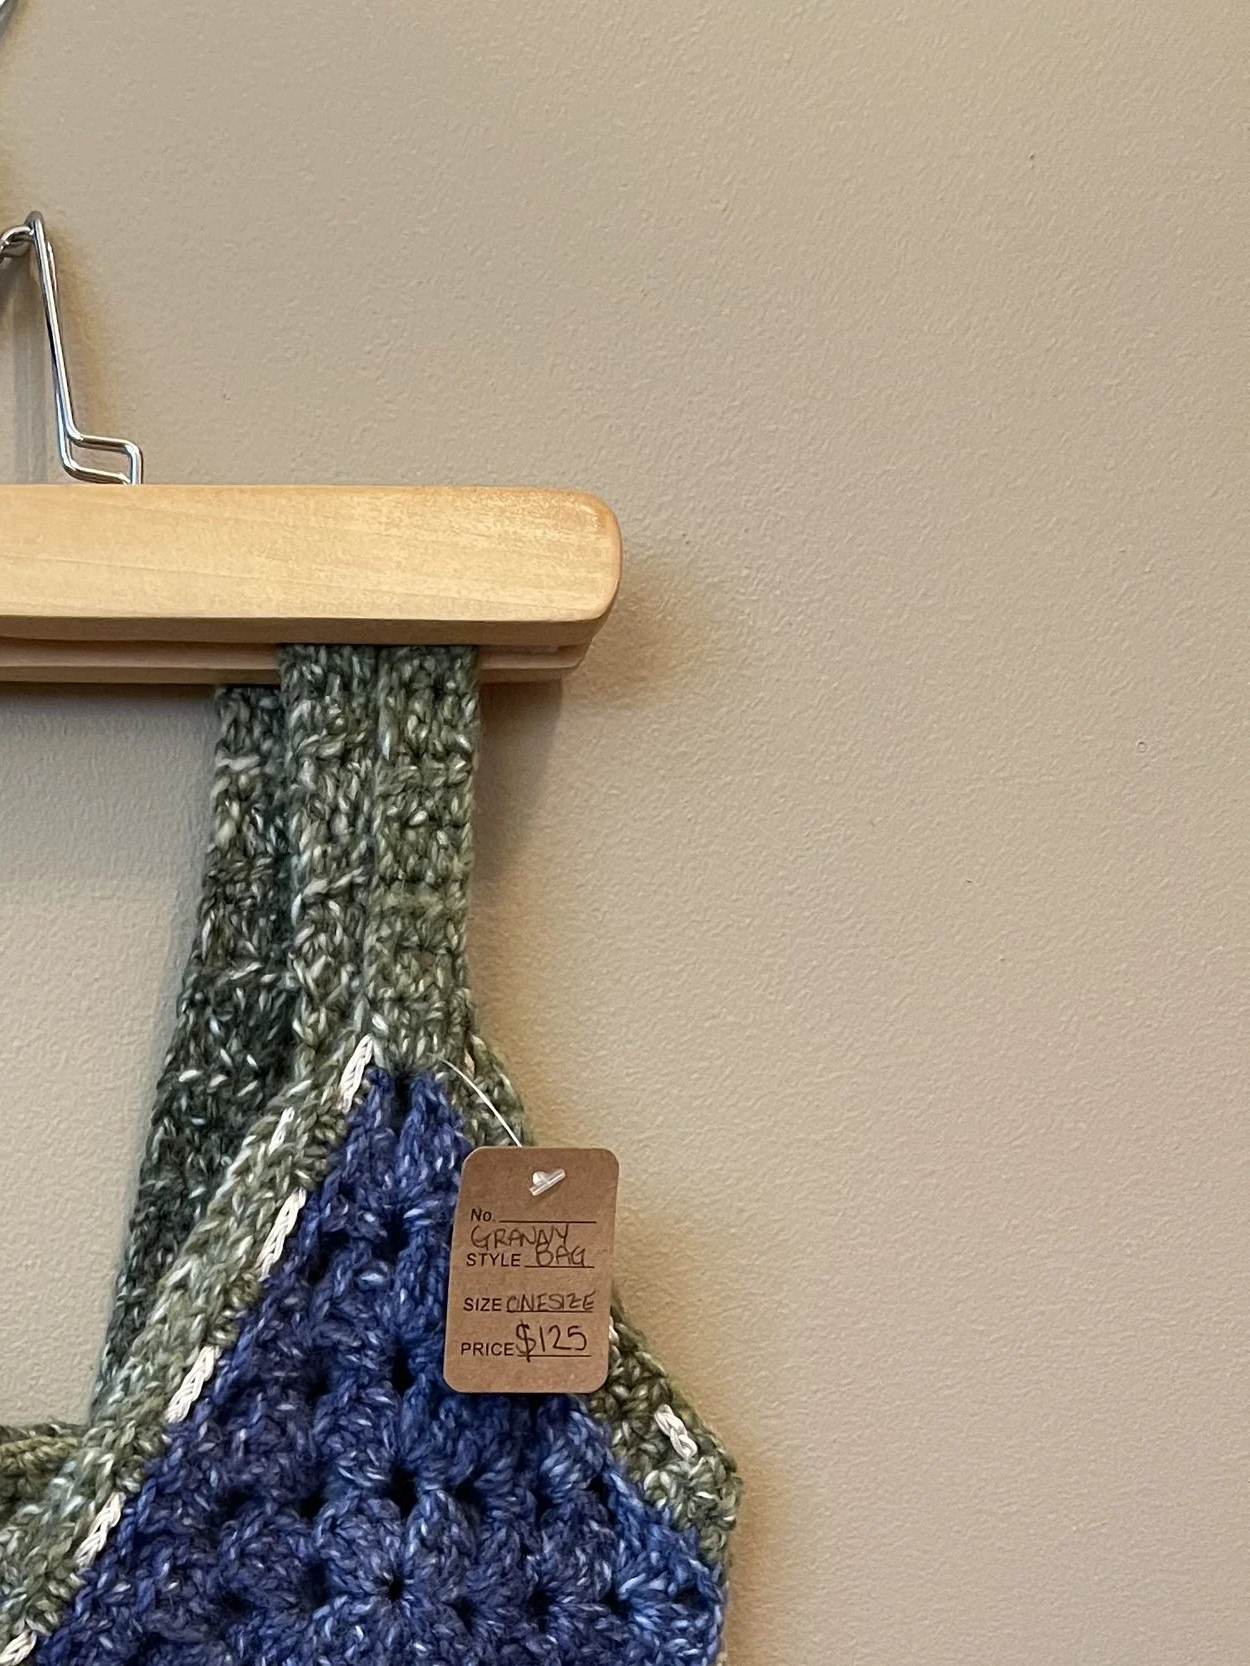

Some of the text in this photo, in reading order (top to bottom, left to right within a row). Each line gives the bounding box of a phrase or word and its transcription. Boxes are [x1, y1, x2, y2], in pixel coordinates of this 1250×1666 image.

[470, 1208, 496, 1223] No.
[470, 1223, 569, 1250] GRANNY
[466, 1244, 586, 1267] STYLE BAG
[463, 1297, 502, 1312] SIZE
[461, 1320, 587, 1363] PRICE $125
